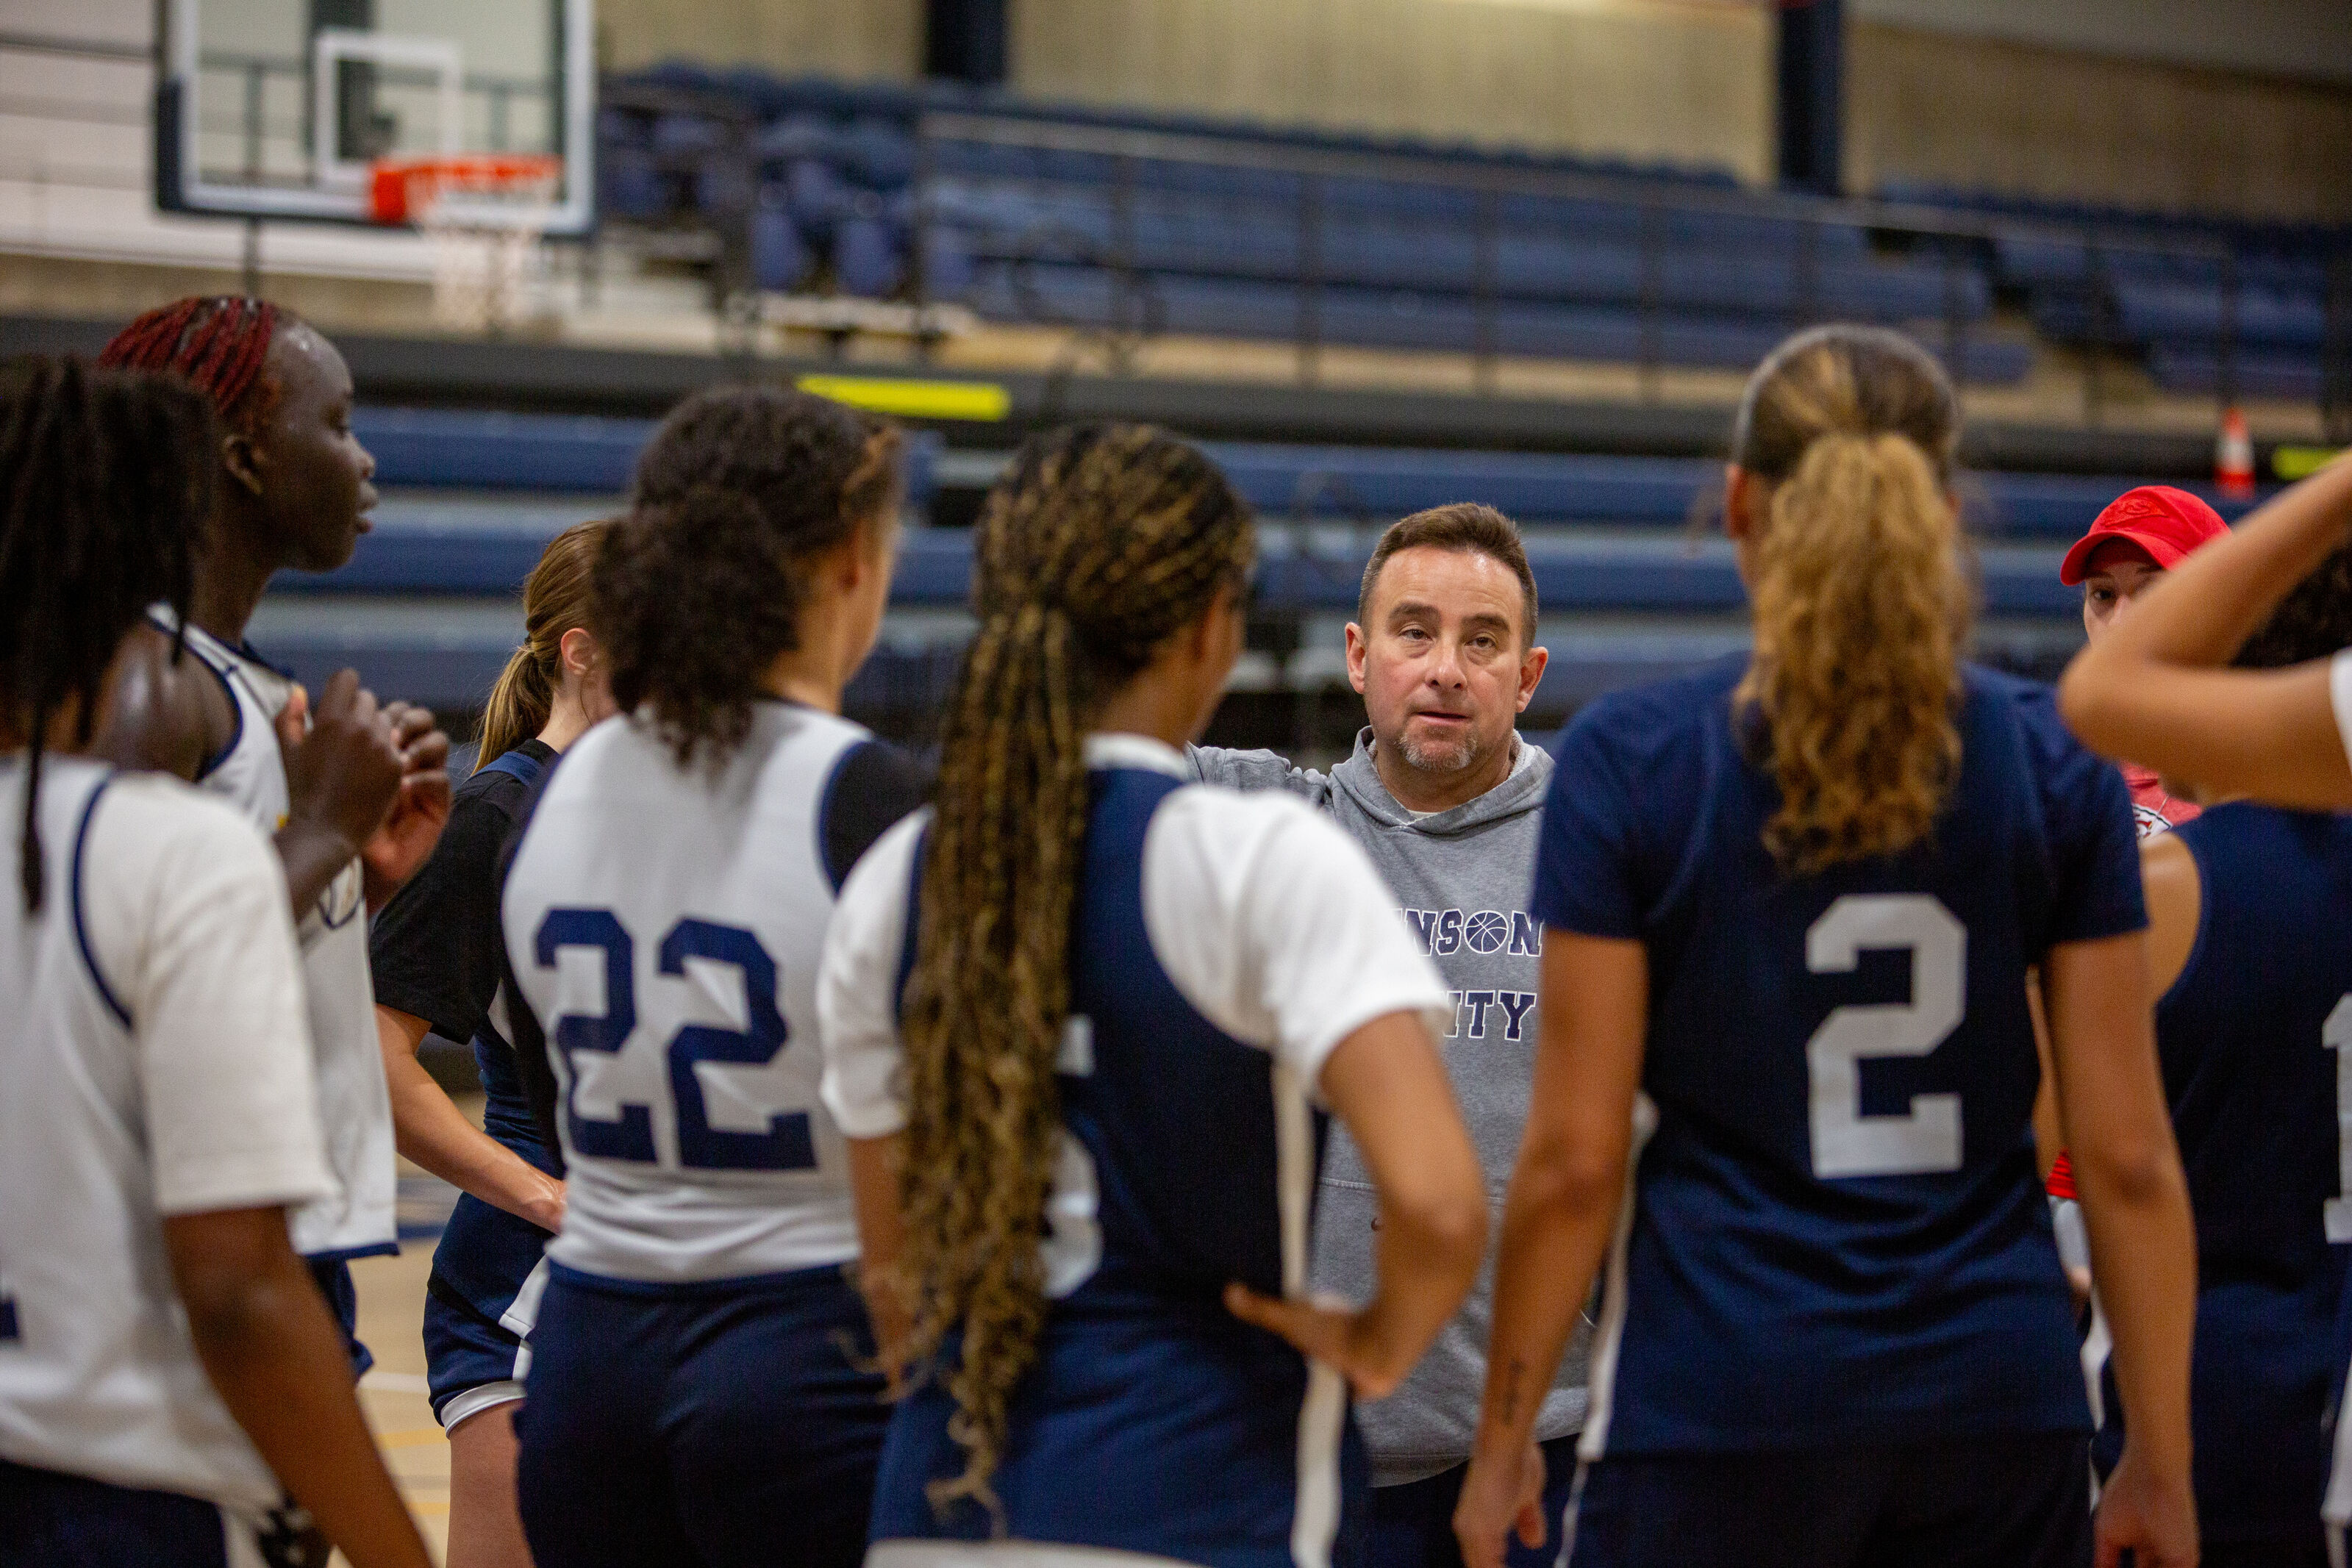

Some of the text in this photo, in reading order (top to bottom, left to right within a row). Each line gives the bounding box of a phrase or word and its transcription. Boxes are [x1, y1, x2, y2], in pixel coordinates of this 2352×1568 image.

[535, 907, 818, 1170] 22
[1392, 908, 1543, 956] NSON
[1806, 894, 1967, 1178] 2
